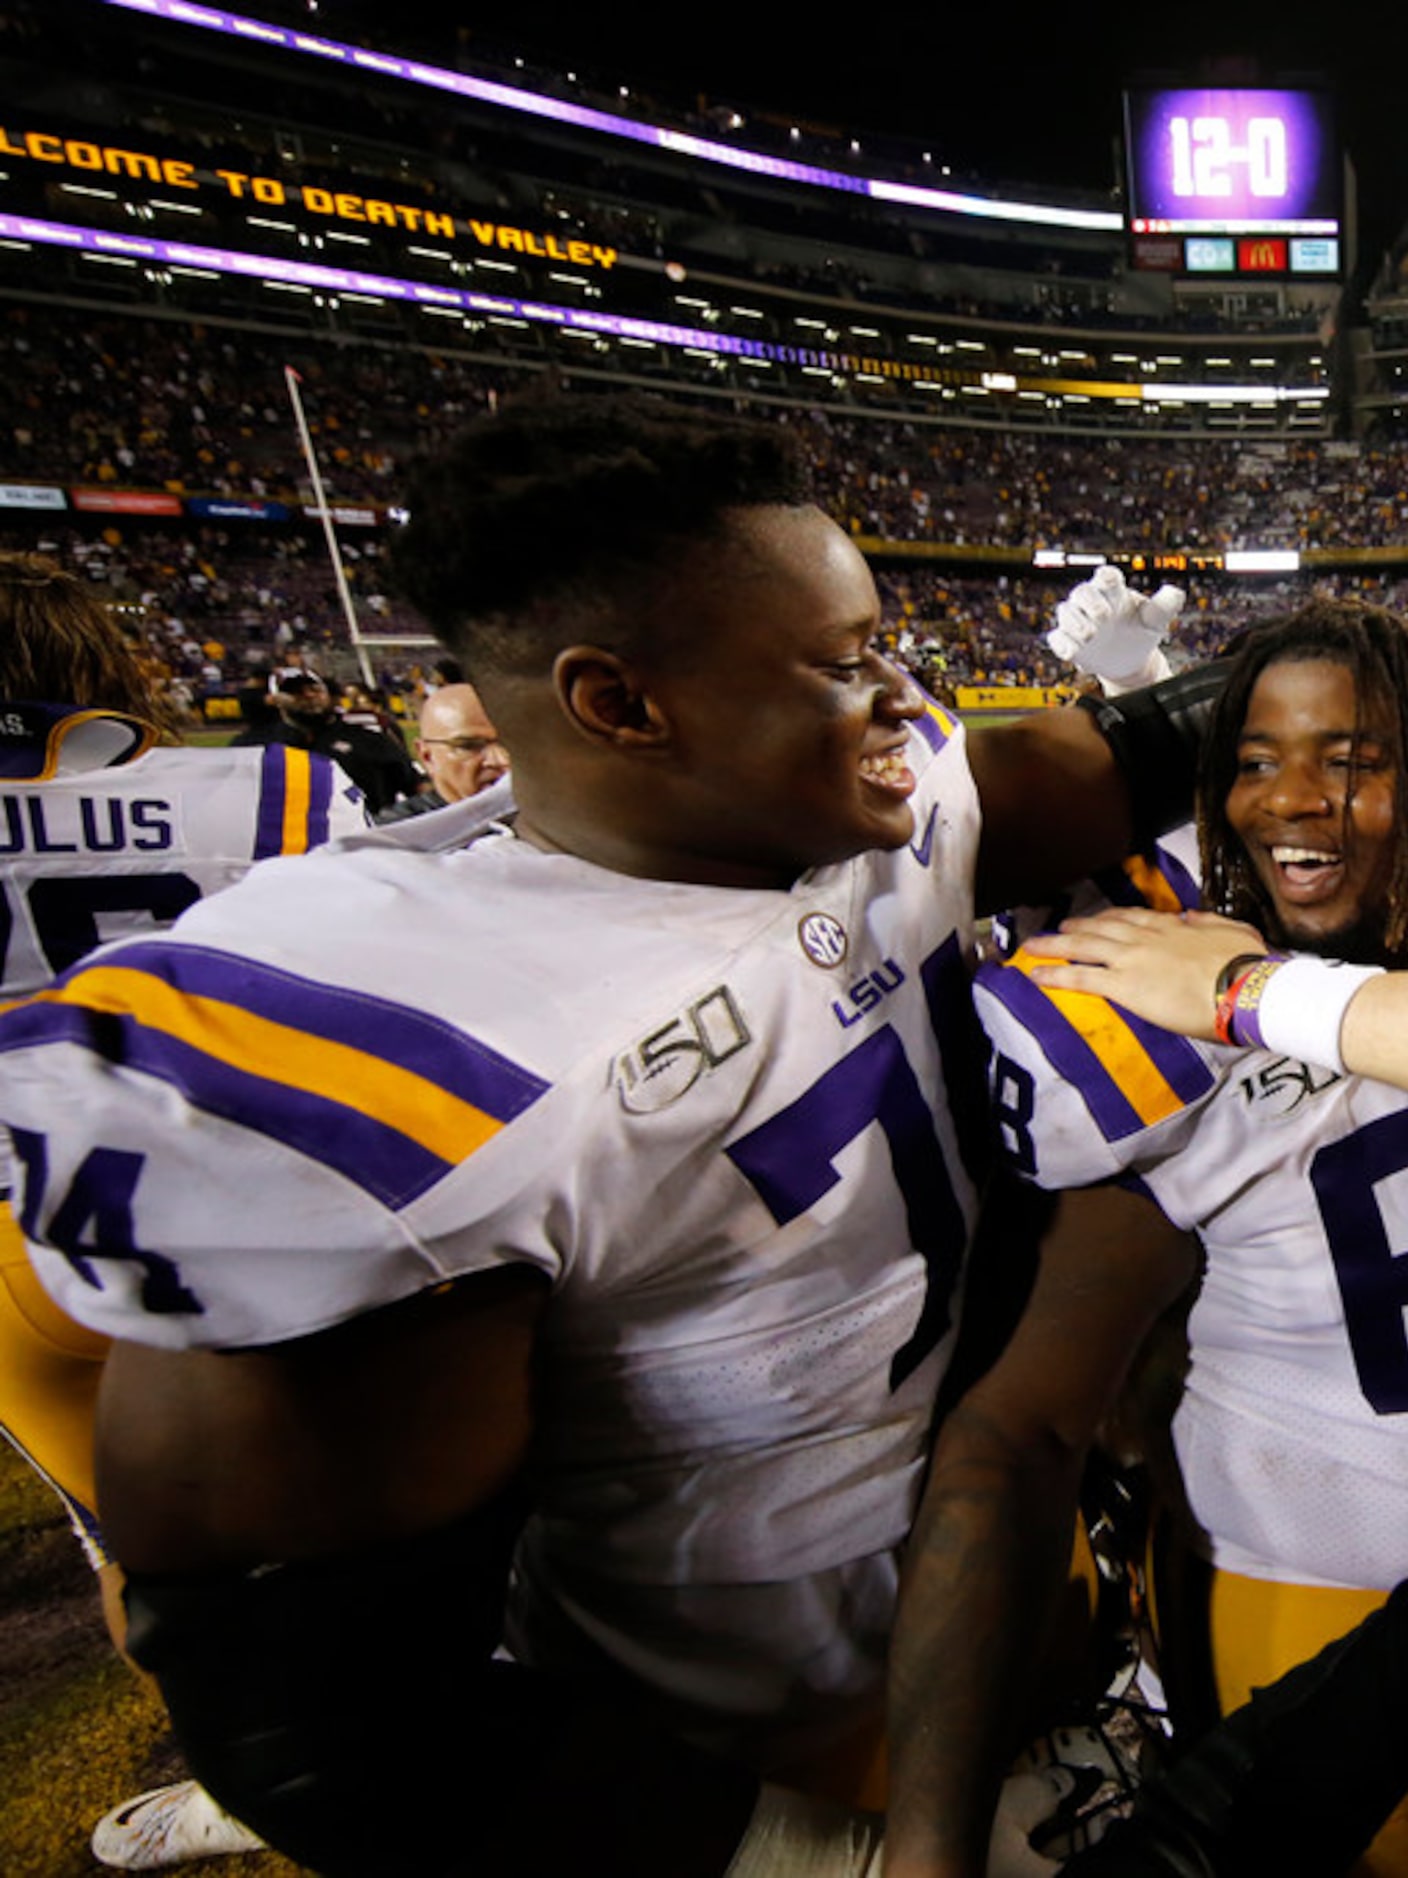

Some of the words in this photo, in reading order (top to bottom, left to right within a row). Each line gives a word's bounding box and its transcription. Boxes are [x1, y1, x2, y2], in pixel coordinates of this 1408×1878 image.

[1170, 117, 1286, 197] 12-0
[216, 169, 286, 205] TO
[301, 186, 455, 238] DEATH
[469, 219, 618, 269] VALLEY
[833, 957, 906, 1029] LSU
